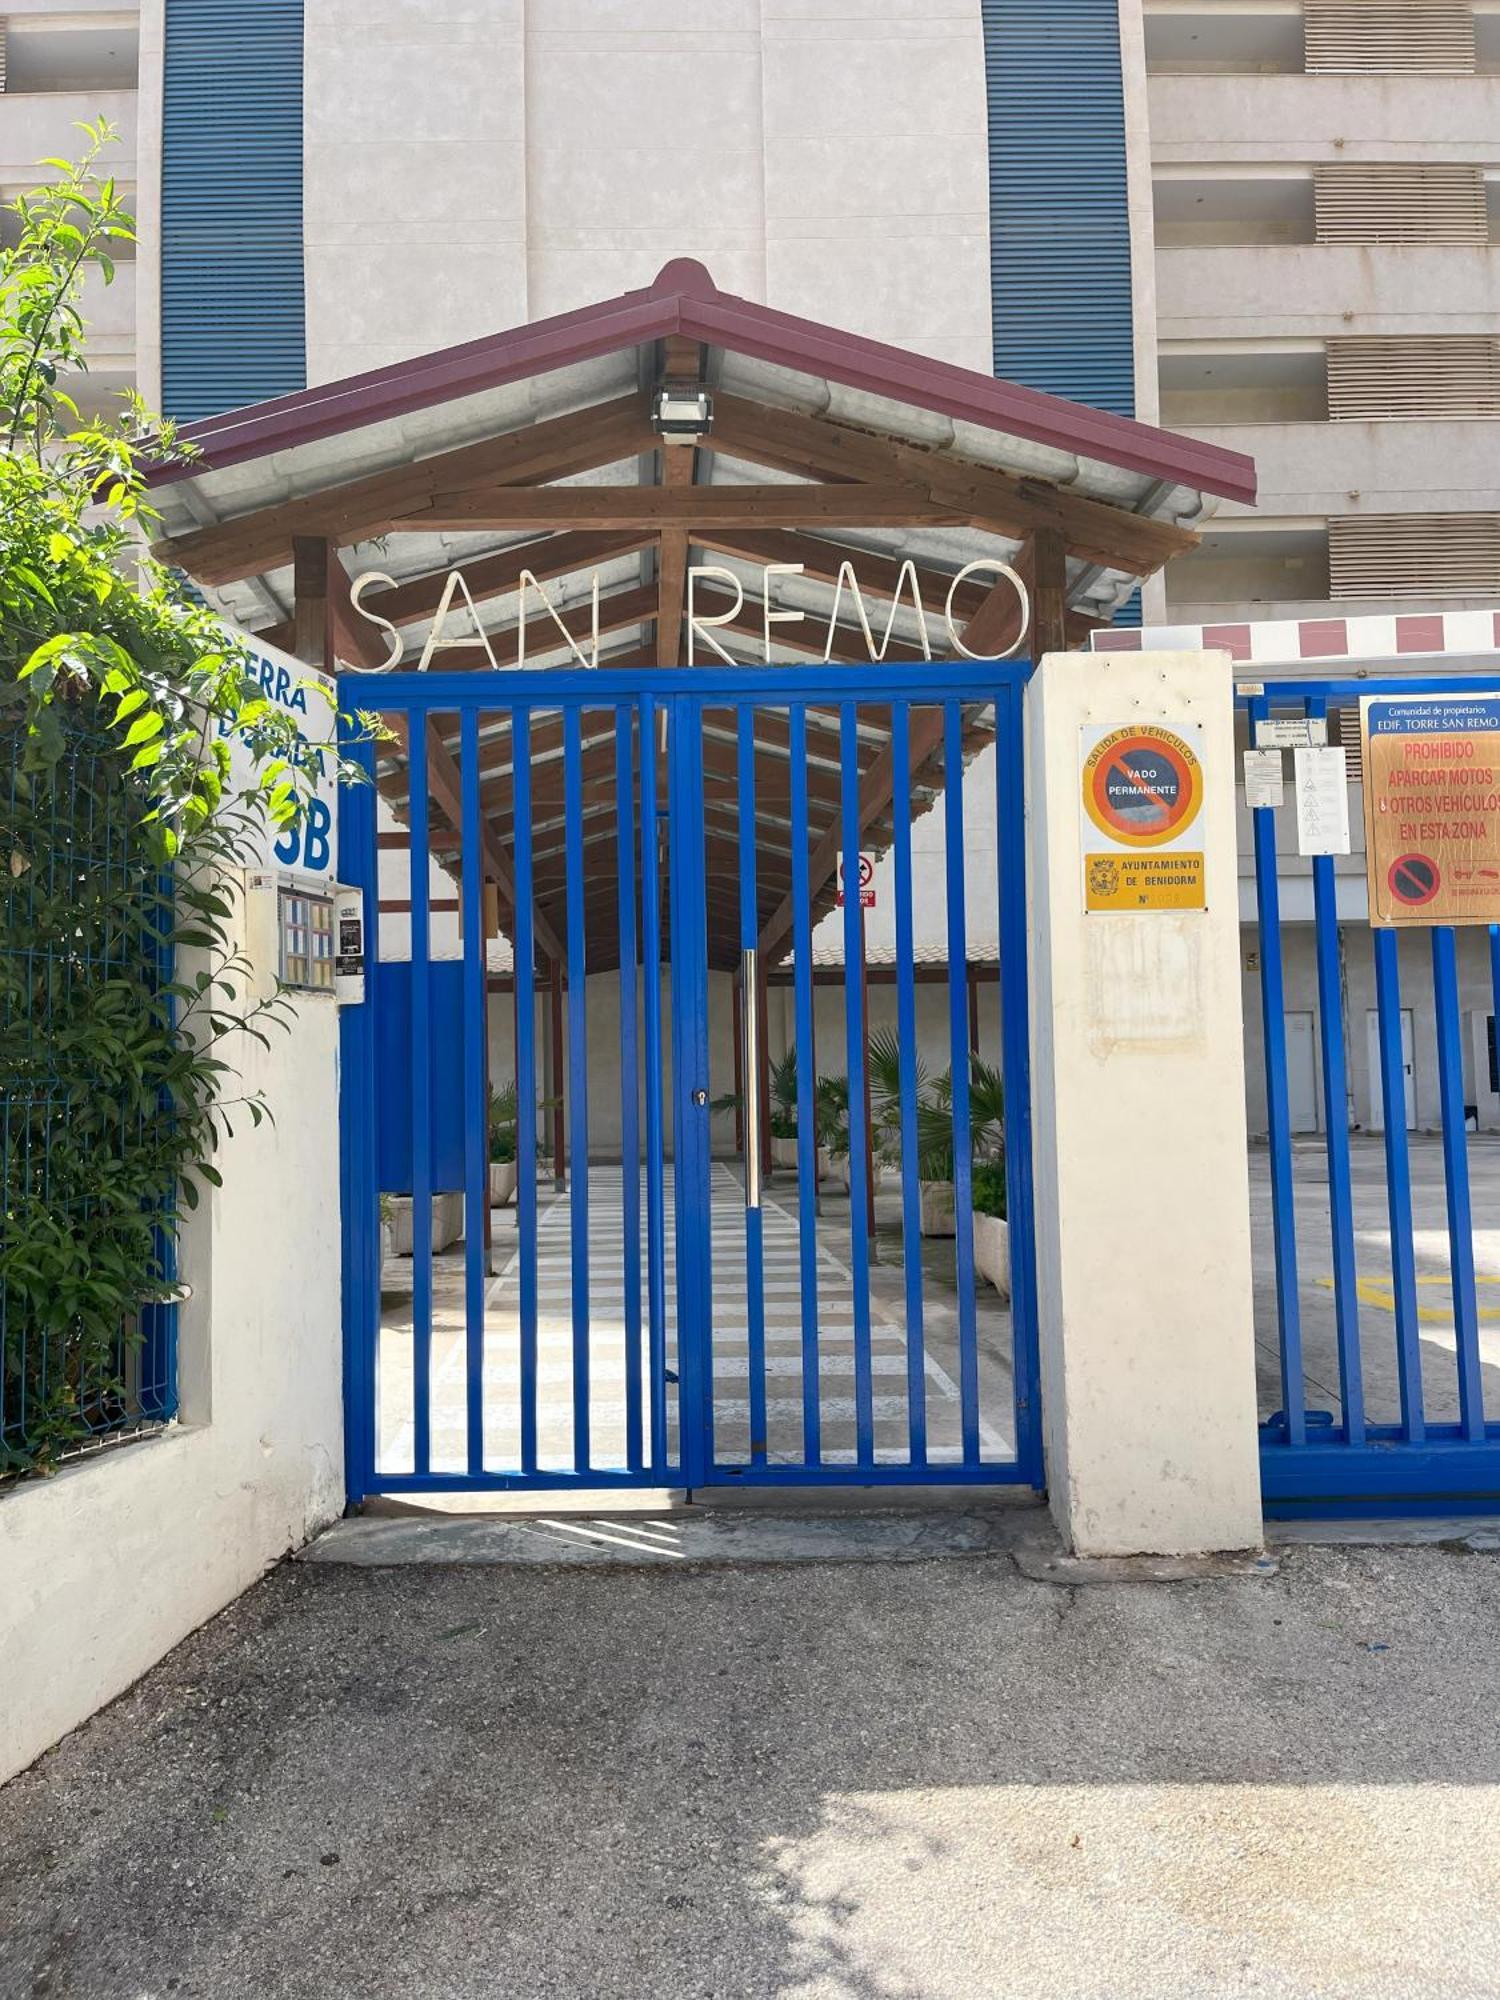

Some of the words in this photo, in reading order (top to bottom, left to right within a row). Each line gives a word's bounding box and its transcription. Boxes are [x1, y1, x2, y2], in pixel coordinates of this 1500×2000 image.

[340, 569, 599, 673] SAN
[688, 559, 1030, 666] REMO
[1388, 706, 1431, 717] Comunidad
[1433, 706, 1442, 716] de
[1443, 705, 1486, 717] propietarios
[1406, 719, 1440, 730] TORRE
[1442, 718, 1464, 729] SAN
[1467, 717, 1498, 728] REMO
[1087, 734, 1118, 768] SALIDA
[1120, 727, 1136, 738] DE
[1140, 726, 1197, 766] VEHICULOS
[1404, 741, 1474, 760] PROHIBIDO
[1127, 770, 1157, 779] VADO
[1388, 768, 1447, 787] APARCAR
[1448, 767, 1493, 785] MOTOS
[1108, 785, 1177, 796] PERMANENTE
[1390, 796, 1432, 814] OTROS
[1400, 823, 1417, 840] EN
[1419, 822, 1449, 840] ESTA
[1451, 821, 1487, 839] ZONA
[1121, 860, 1200, 870] AYUNTAMIENTO
[1126, 876, 1138, 886] DE
[1145, 875, 1197, 886] BENIDORM
